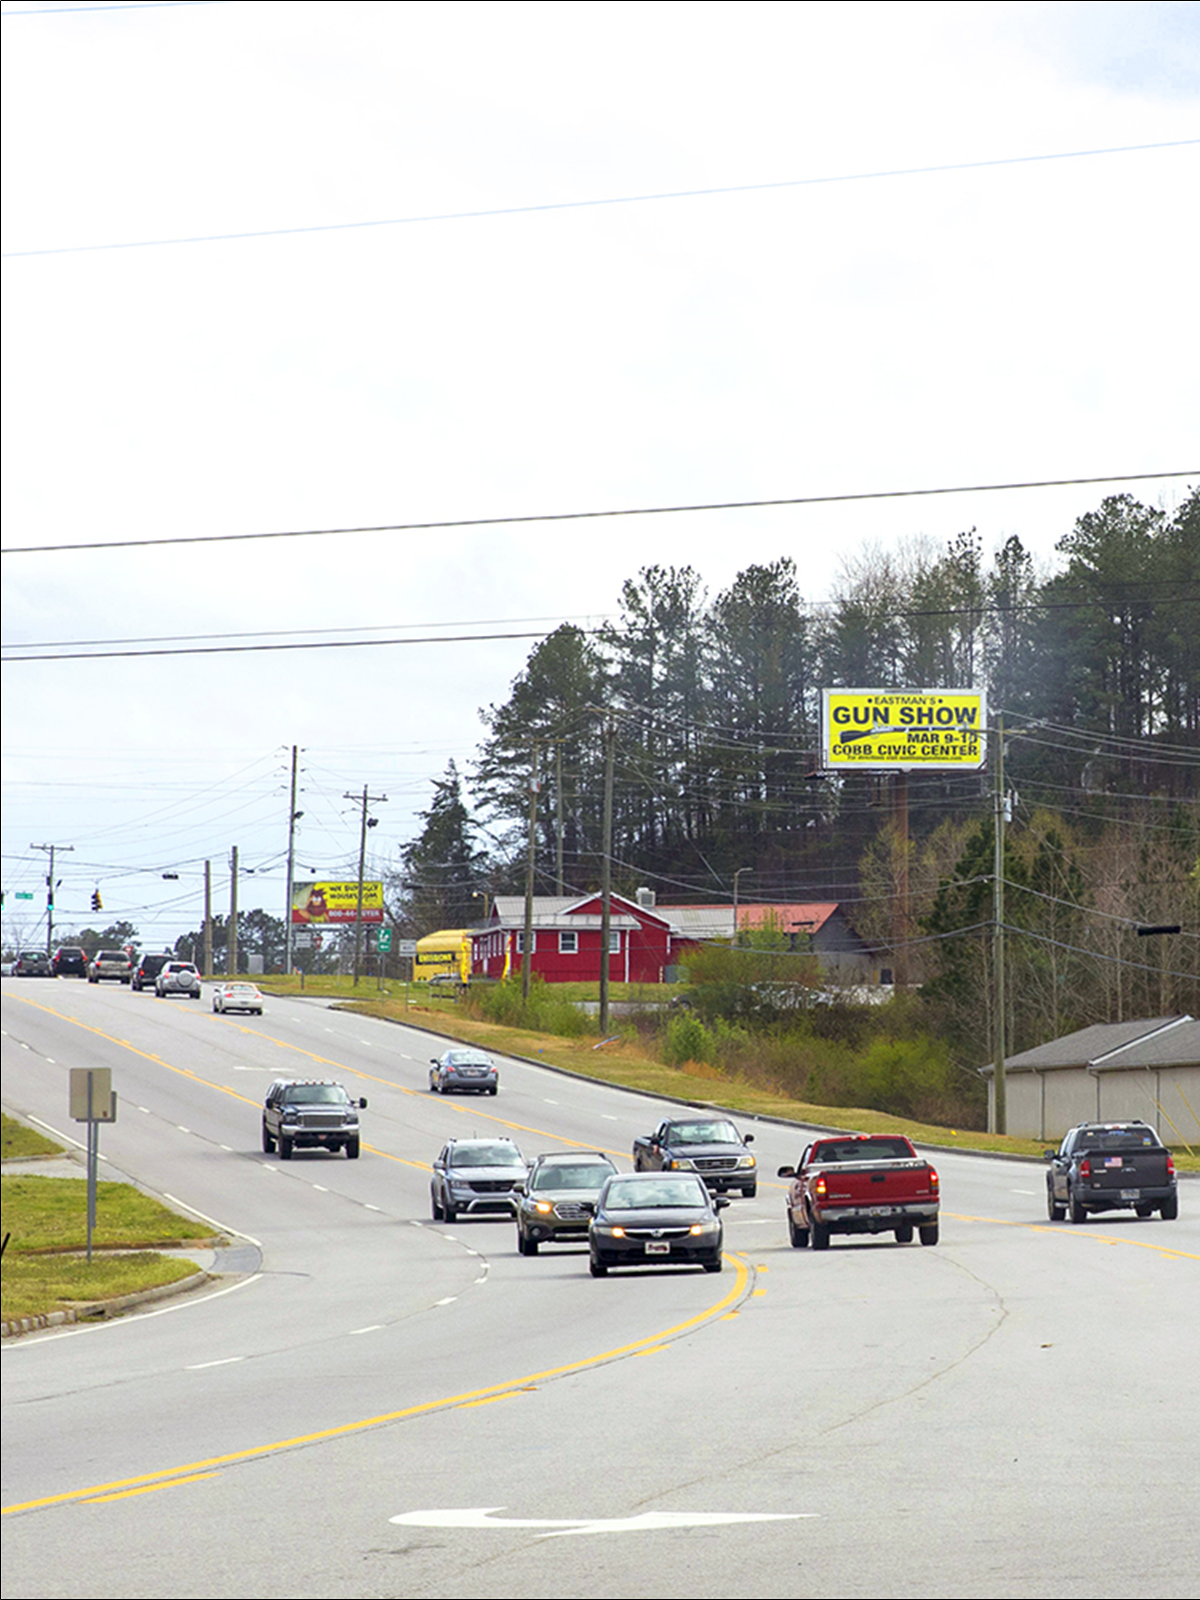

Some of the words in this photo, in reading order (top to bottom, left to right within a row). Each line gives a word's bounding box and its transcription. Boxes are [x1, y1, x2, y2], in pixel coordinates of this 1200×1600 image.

[875, 697, 936, 705] EASTMAN'S
[833, 706, 889, 724] GUN
[900, 706, 977, 725] SHOW
[907, 733, 940, 744] MAR
[944, 733, 978, 744] 9-10
[833, 744, 873, 756] COBB
[878, 744, 916, 756] CIVIC
[921, 744, 978, 756] CENTER
